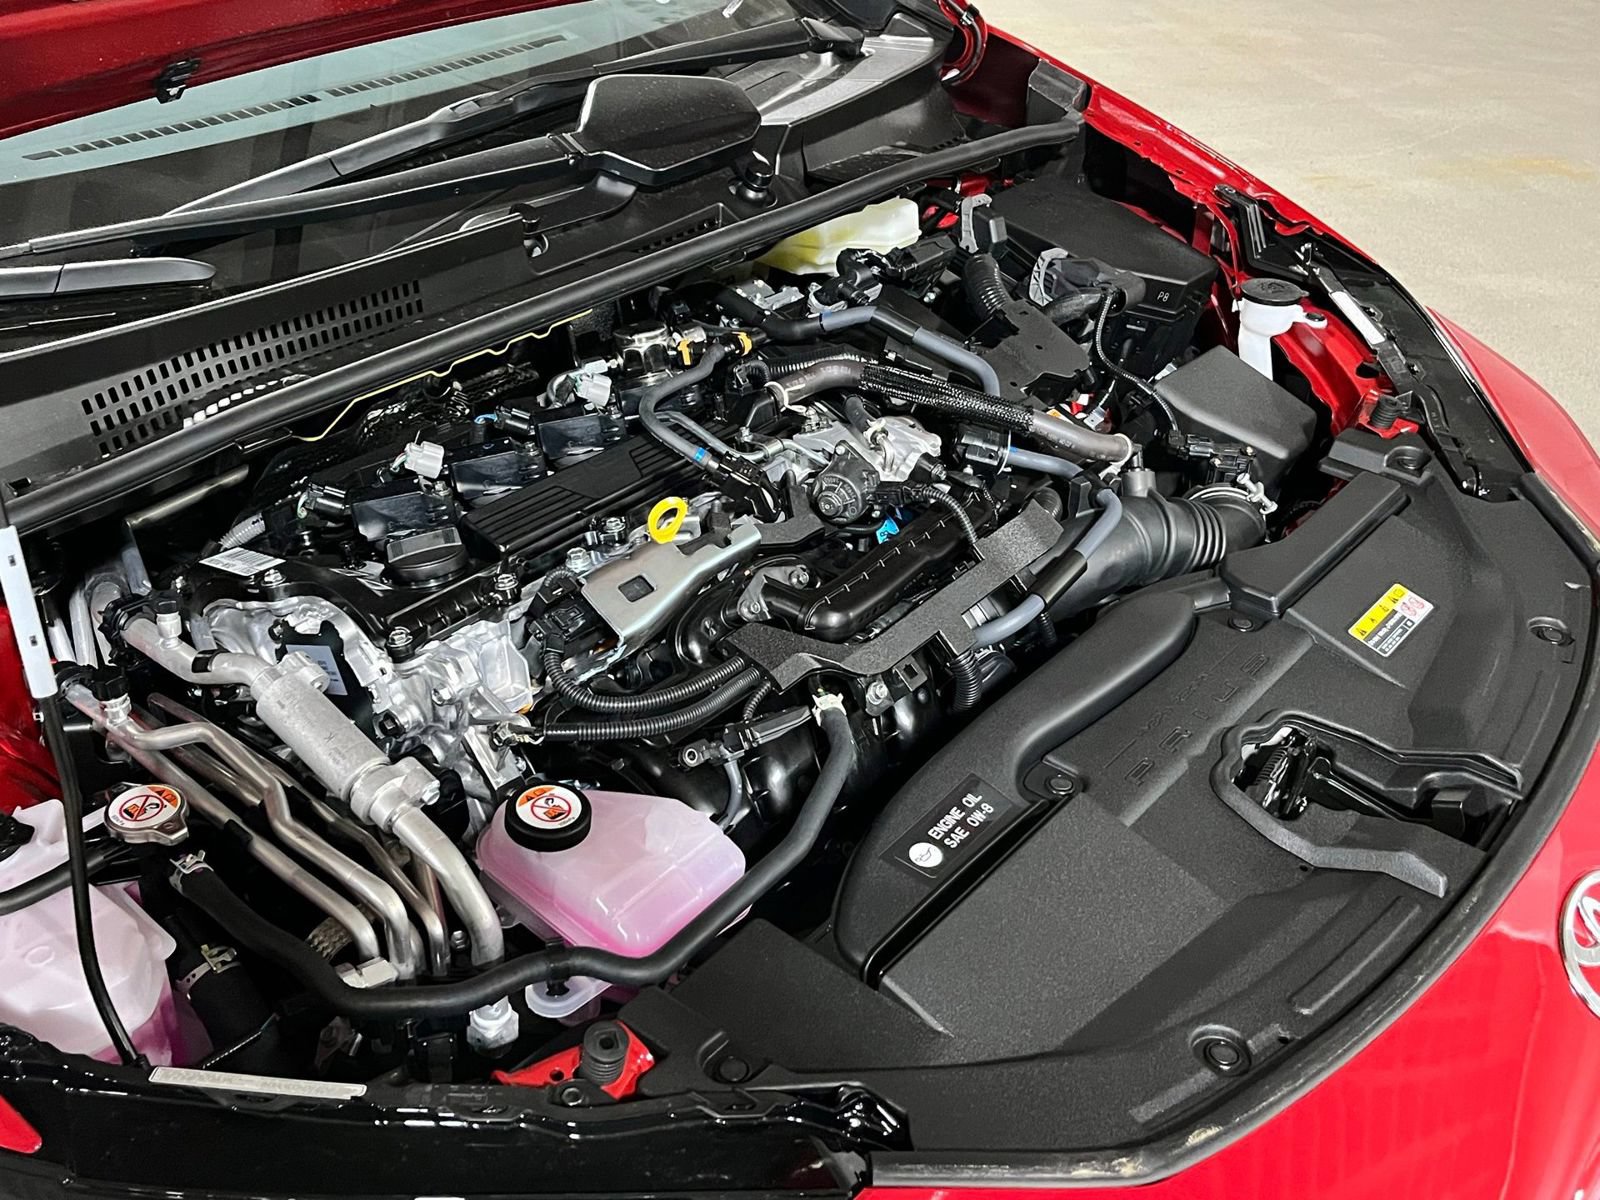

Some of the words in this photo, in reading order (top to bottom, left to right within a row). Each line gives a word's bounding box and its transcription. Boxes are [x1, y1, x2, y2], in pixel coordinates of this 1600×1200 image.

[1124, 653, 1269, 787] PRIUS
[927, 806, 966, 840] ENGINE
[961, 793, 983, 808] OIL
[943, 826, 970, 848] SAE
[966, 802, 994, 827] 0W-8
